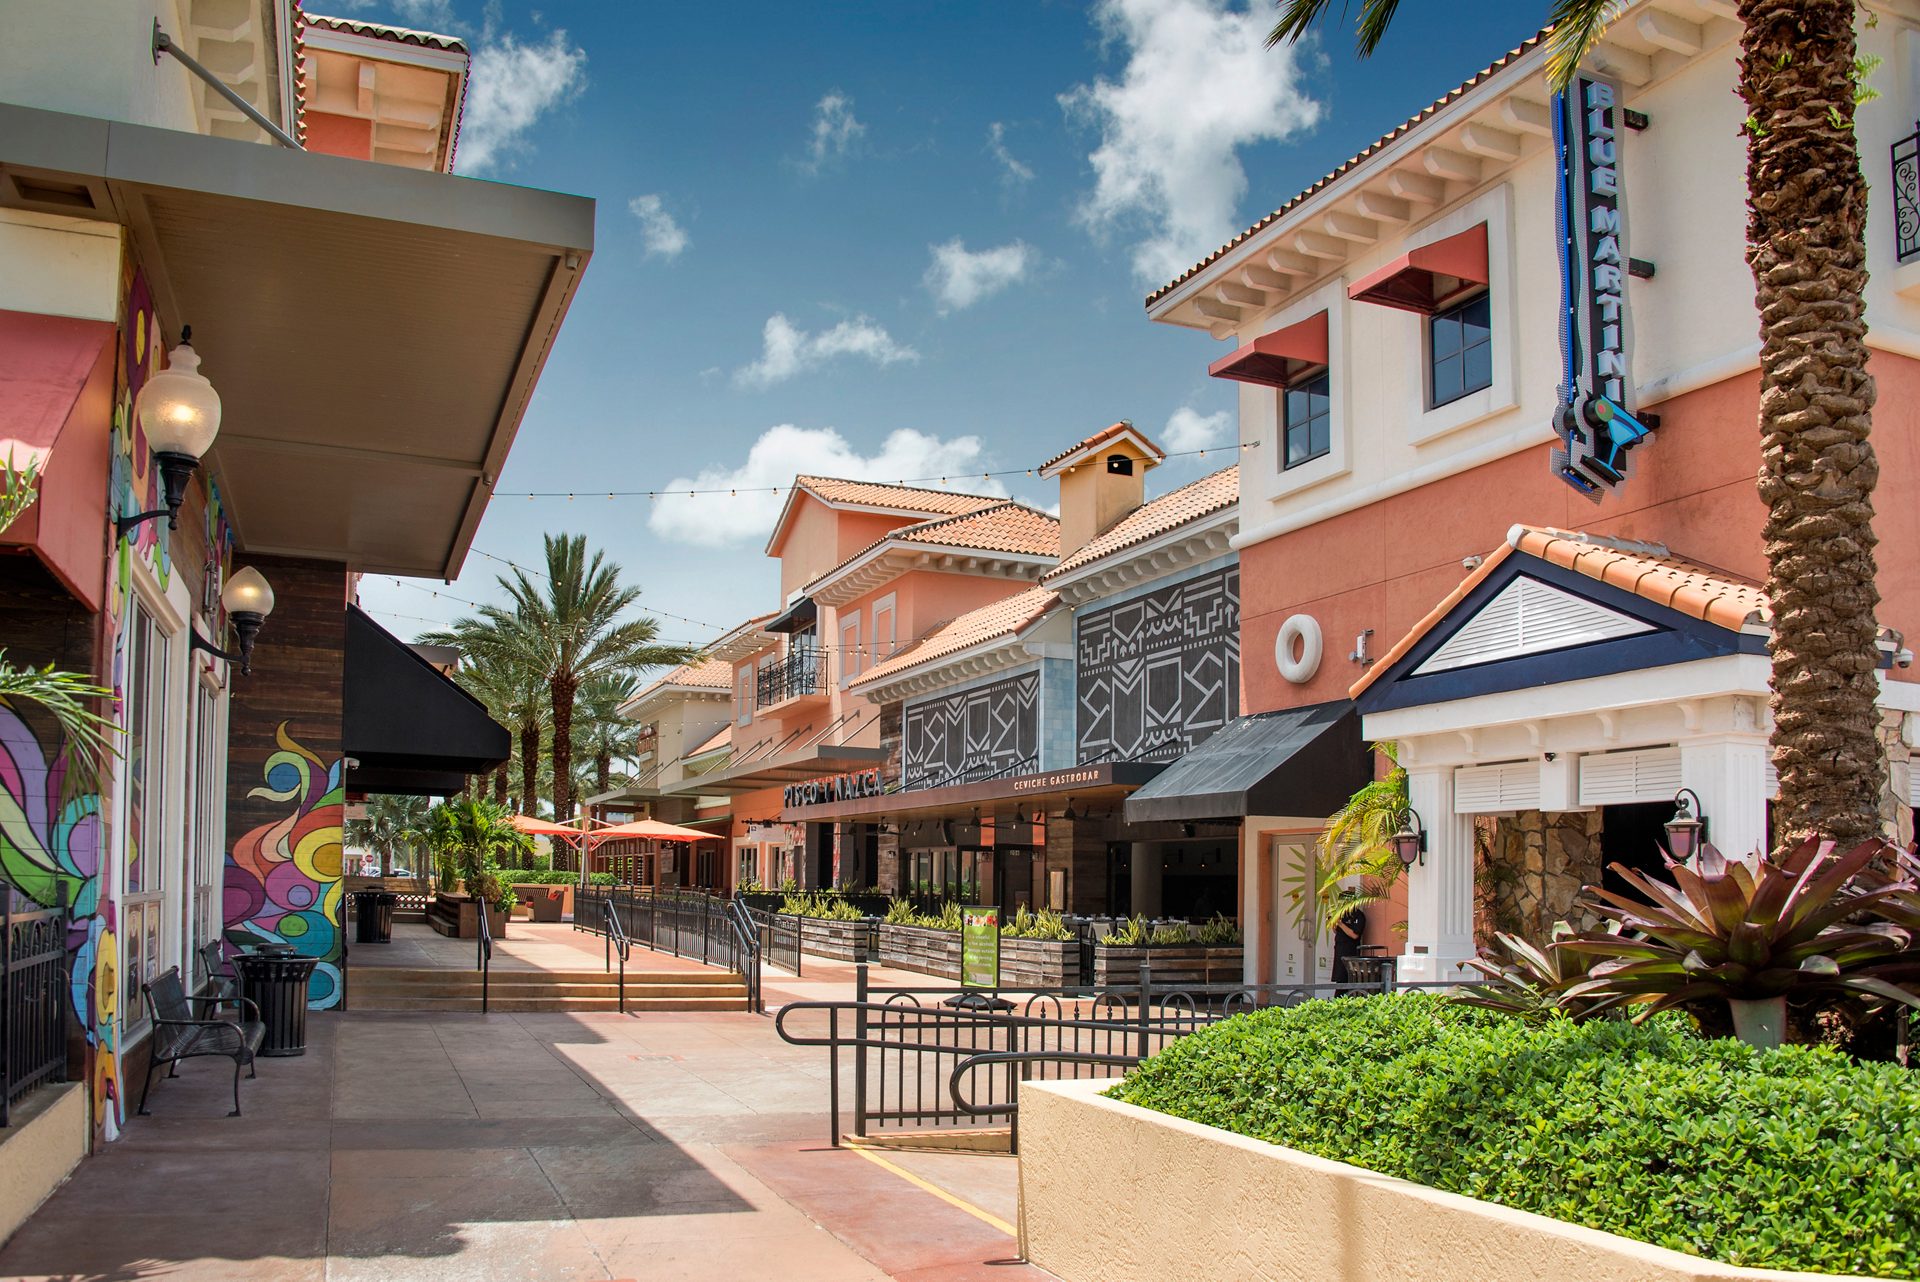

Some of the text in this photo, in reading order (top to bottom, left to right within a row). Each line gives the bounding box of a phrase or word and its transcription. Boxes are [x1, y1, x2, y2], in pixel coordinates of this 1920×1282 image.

[1587, 80, 1625, 400] BLUE MARTINI
[784, 780, 820, 808] PISCO
[835, 769, 882, 801] NAZCA
[1014, 770, 1099, 790] CEVICHE GASTROBAR
